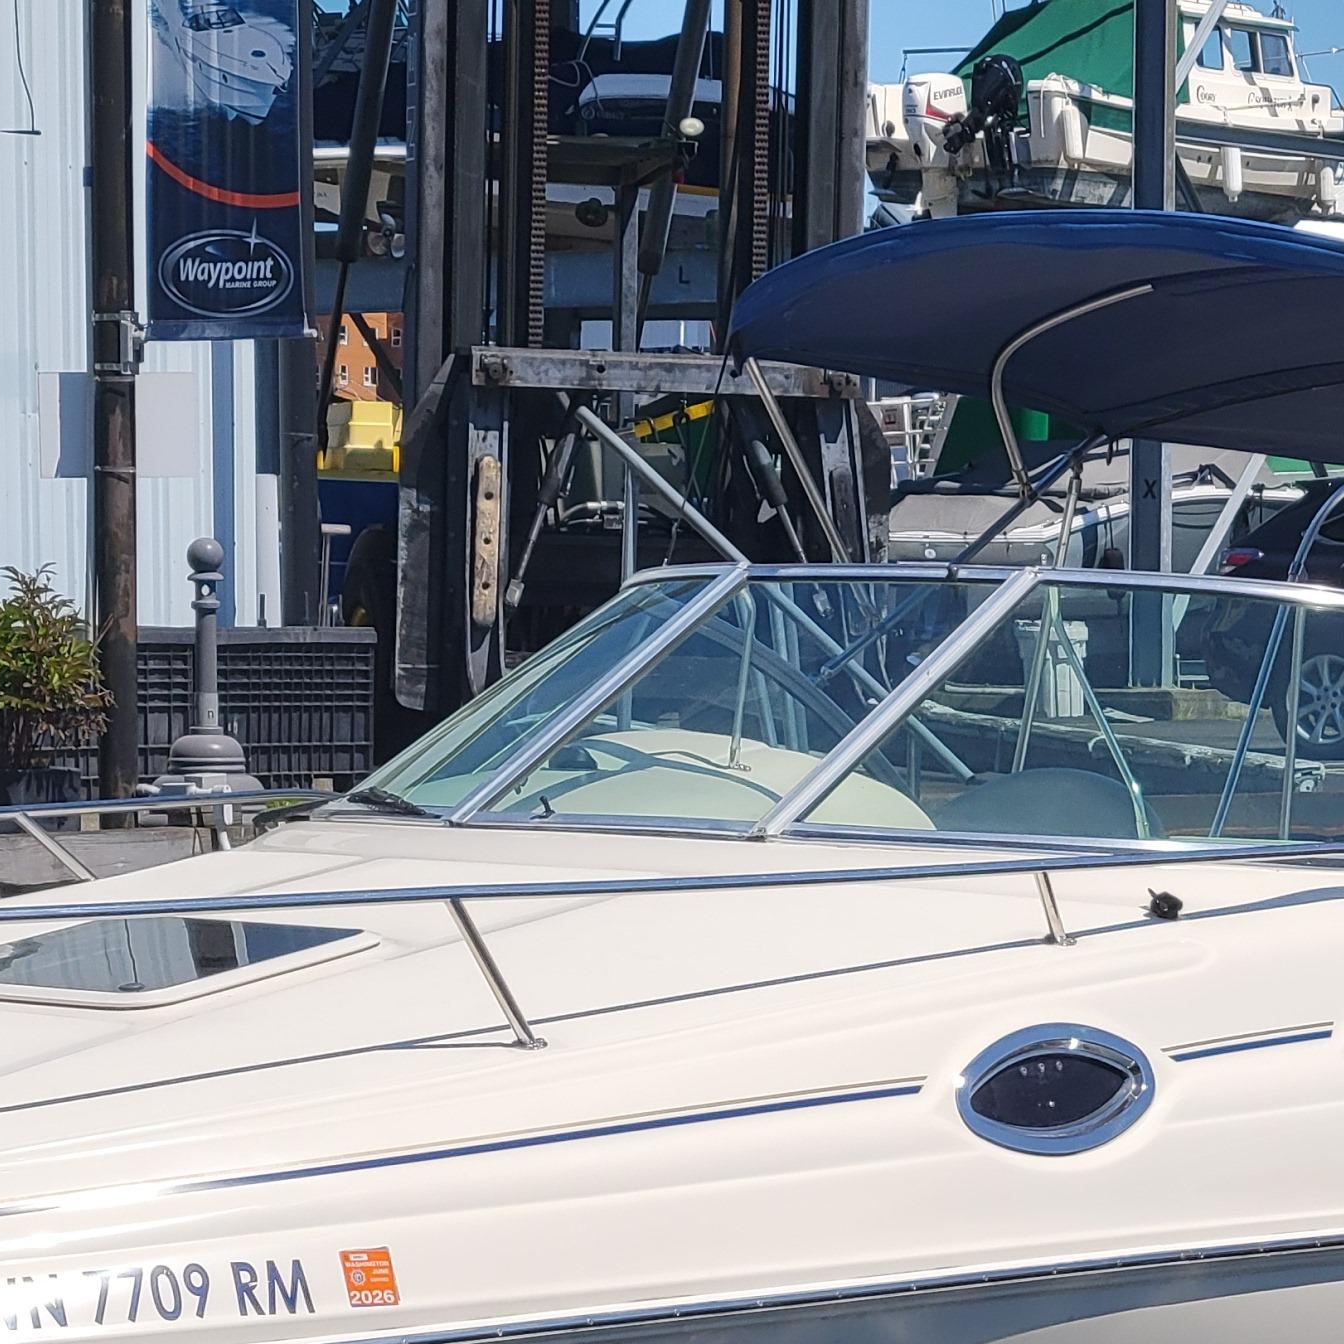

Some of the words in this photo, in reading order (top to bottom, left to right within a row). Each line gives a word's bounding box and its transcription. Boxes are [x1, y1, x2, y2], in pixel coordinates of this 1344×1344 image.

[179, 257, 274, 289] Waypoint
[225, 281, 252, 289] MARINE
[253, 280, 277, 288] GROUP
[82, 1262, 211, 1326] 7709
[230, 1258, 317, 1317] RM
[350, 1290, 396, 1304] 2026
